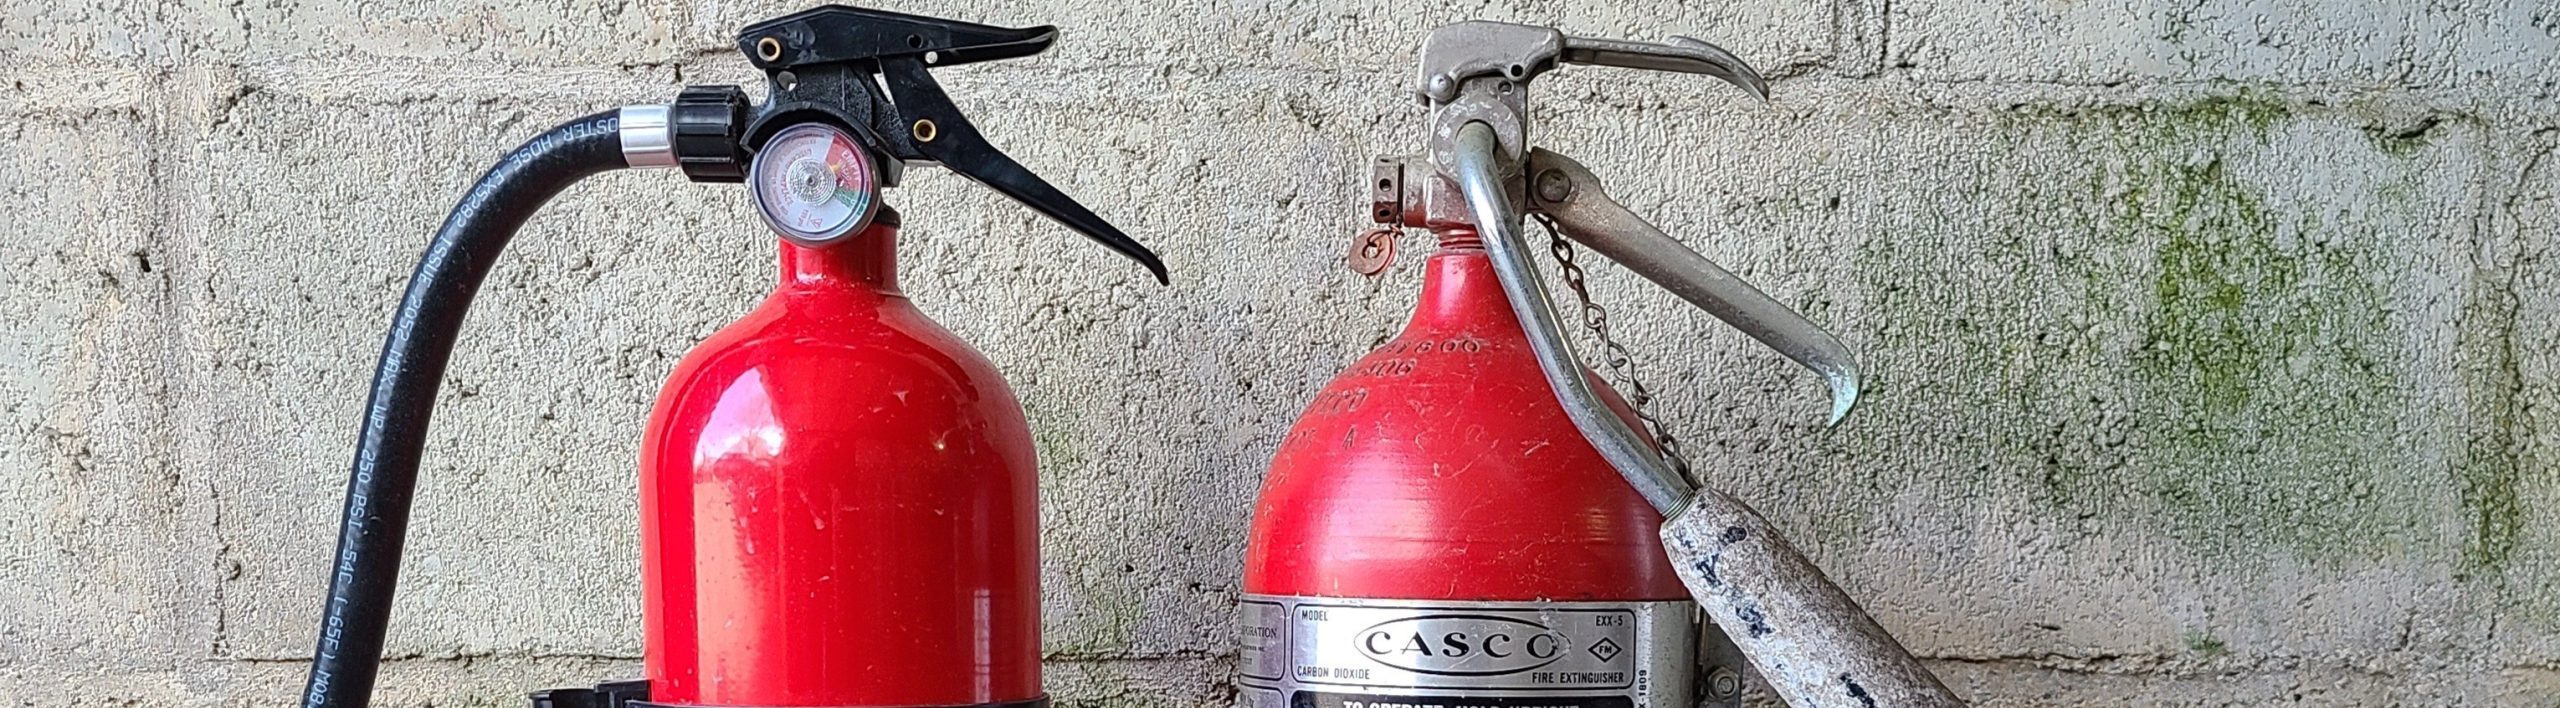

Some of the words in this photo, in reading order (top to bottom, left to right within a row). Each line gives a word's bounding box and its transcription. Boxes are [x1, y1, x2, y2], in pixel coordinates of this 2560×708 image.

[417, 235, 453, 288] ISSUE
[395, 294, 422, 342] 2052
[378, 350, 403, 390] MAX.
[357, 448, 376, 484] 250
[348, 493, 368, 528] PSI
[338, 539, 358, 584] -54C
[1301, 610, 1328, 621] MODEL
[1595, 615, 1623, 627] EXX-5
[1366, 631, 1559, 659] CASCO
[1598, 645, 1613, 654] FM
[306, 669, 332, 708] M08
[1297, 666, 1329, 677] CARBON
[1334, 668, 1370, 679] DIOXIDE
[1532, 672, 1554, 684] FIRE
[1559, 672, 1624, 684] EXTINGUISHER
